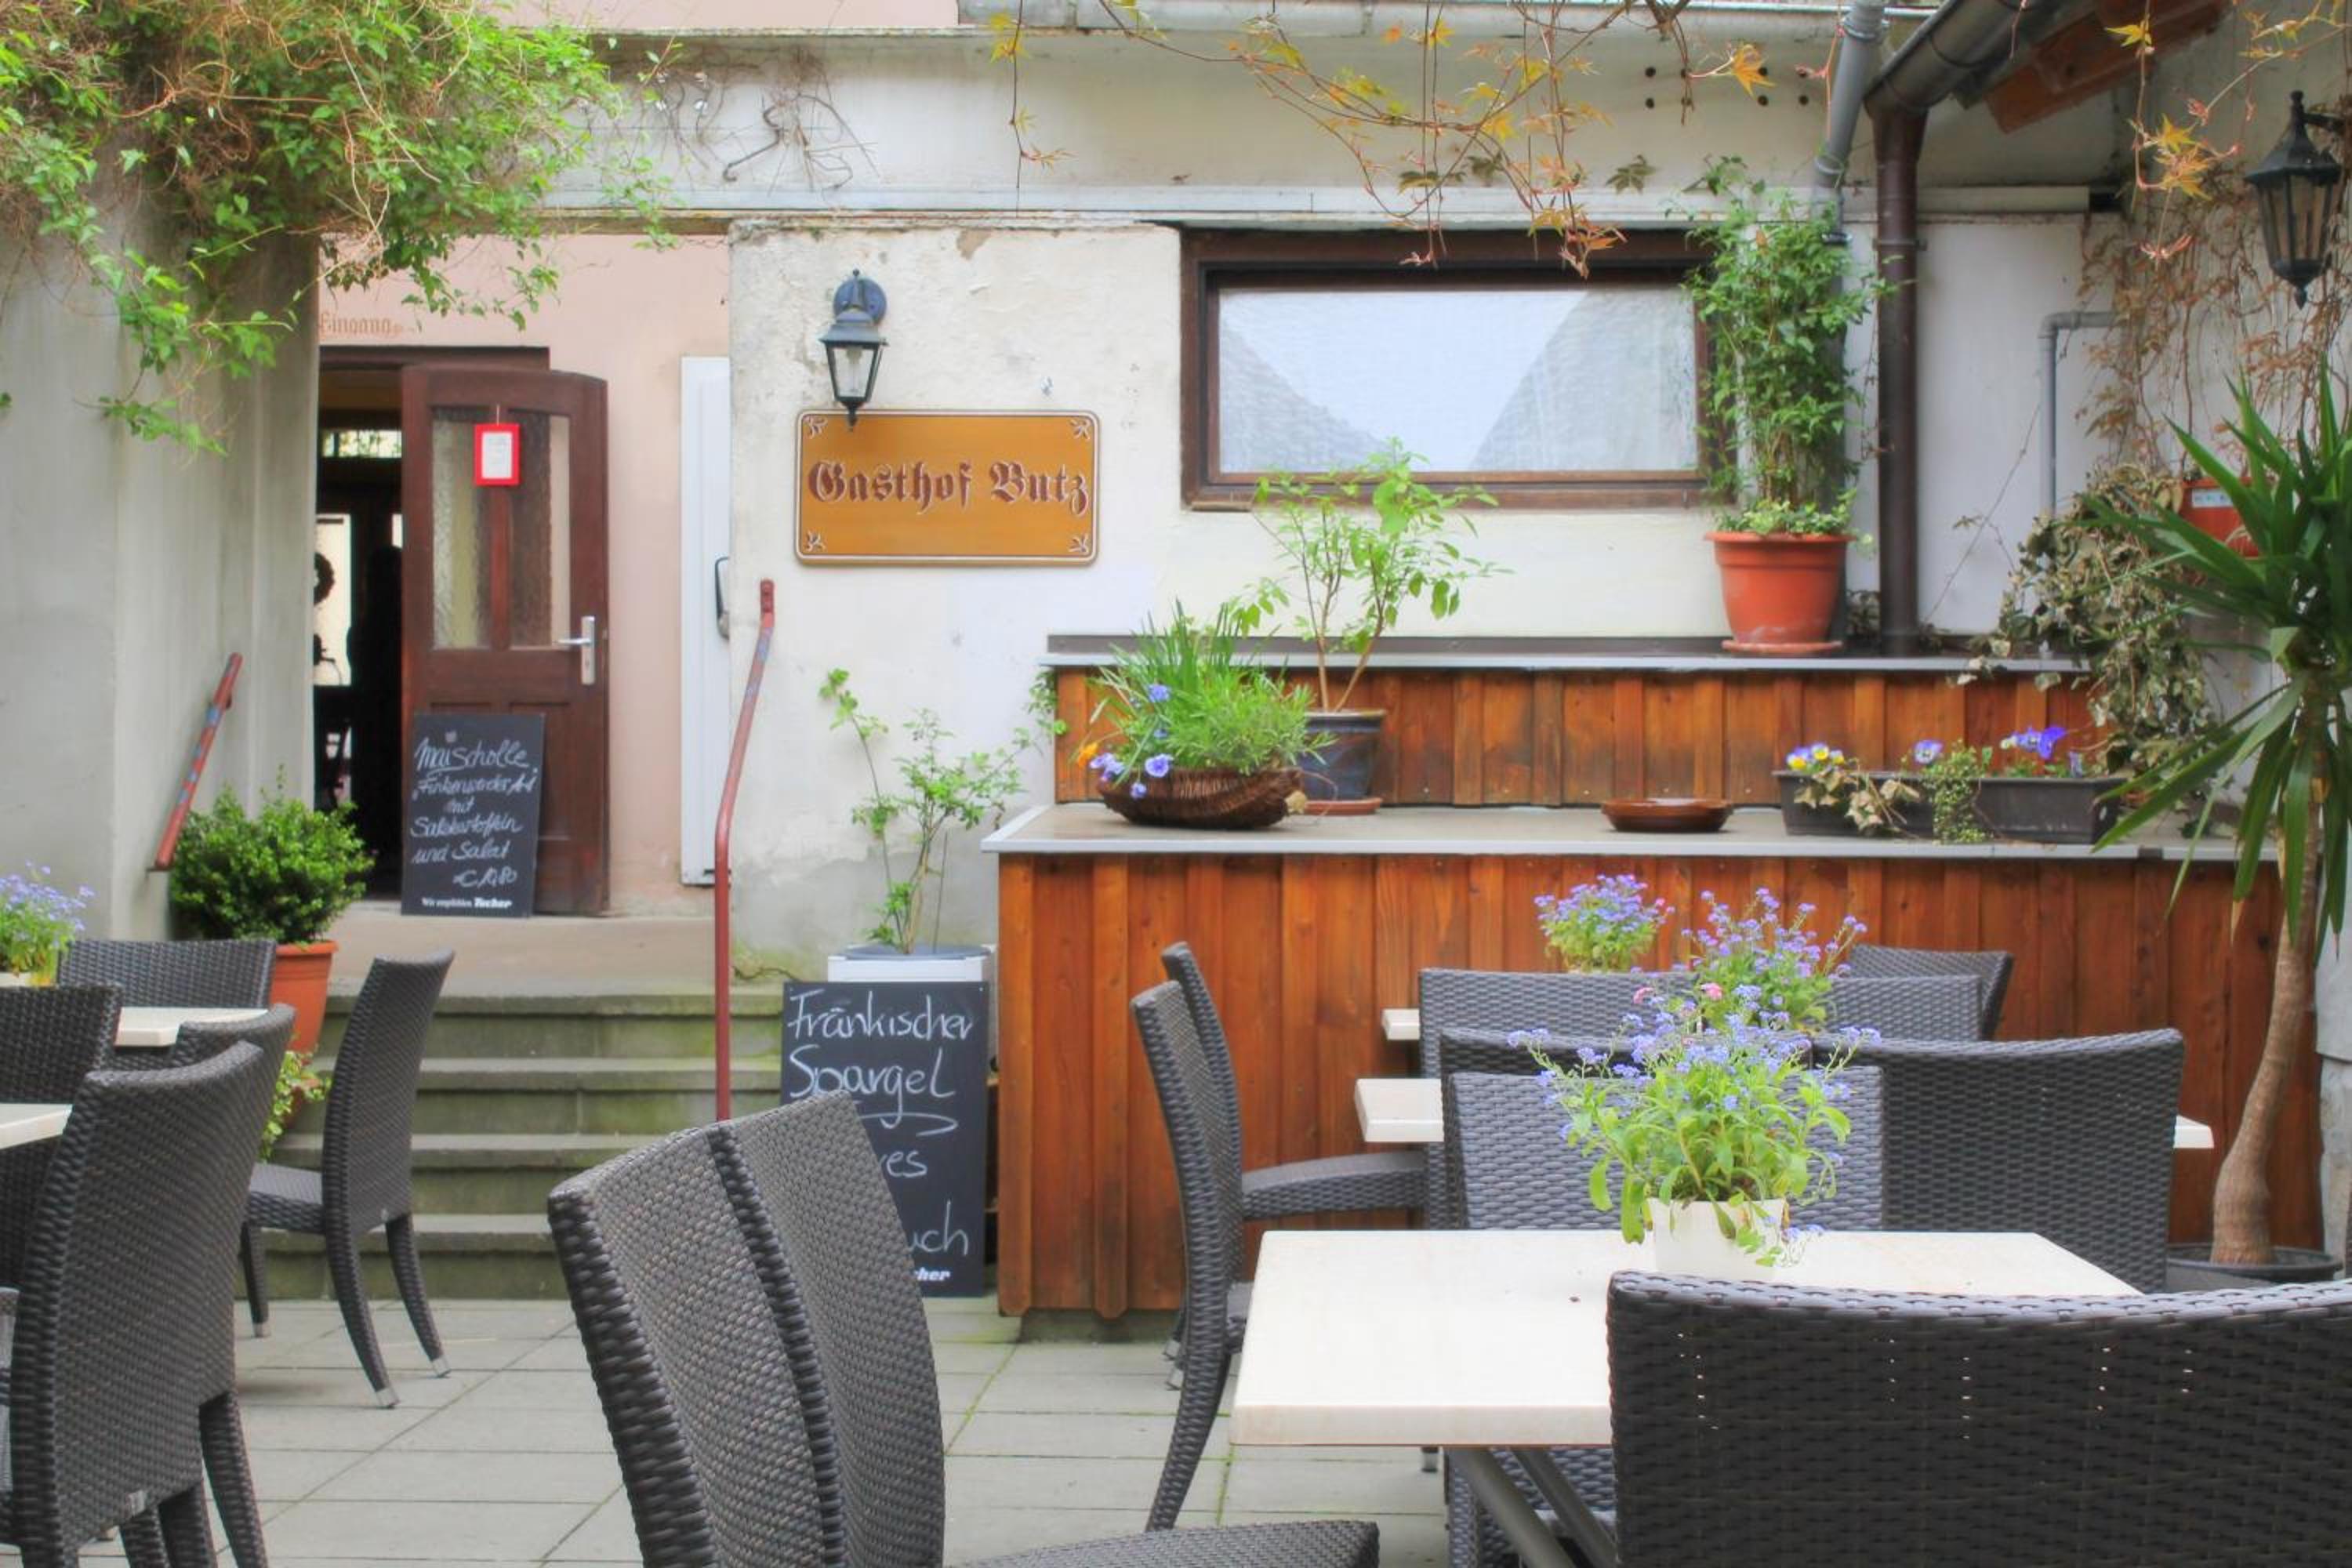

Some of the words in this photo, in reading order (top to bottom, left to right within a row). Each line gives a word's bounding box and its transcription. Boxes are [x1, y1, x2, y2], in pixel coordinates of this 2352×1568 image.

[808, 460, 971, 515] Gasthof
[989, 461, 1090, 517] Butz
[787, 989, 973, 1041] Fränkischer
